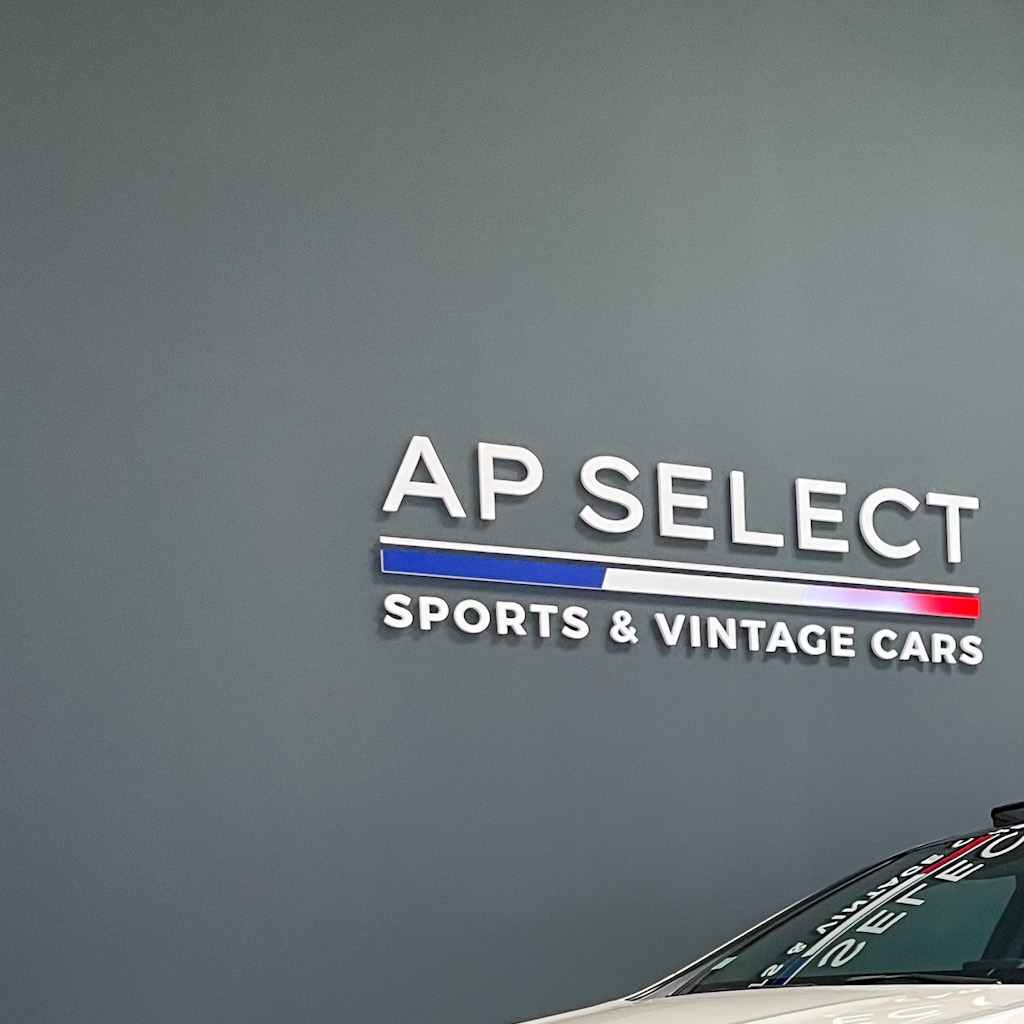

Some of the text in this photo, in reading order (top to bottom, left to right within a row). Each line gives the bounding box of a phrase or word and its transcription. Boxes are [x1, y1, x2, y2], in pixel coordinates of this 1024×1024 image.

[382, 435, 980, 564] AP SELECT
[383, 594, 984, 666] SPORTS & VINTAGE CARS
